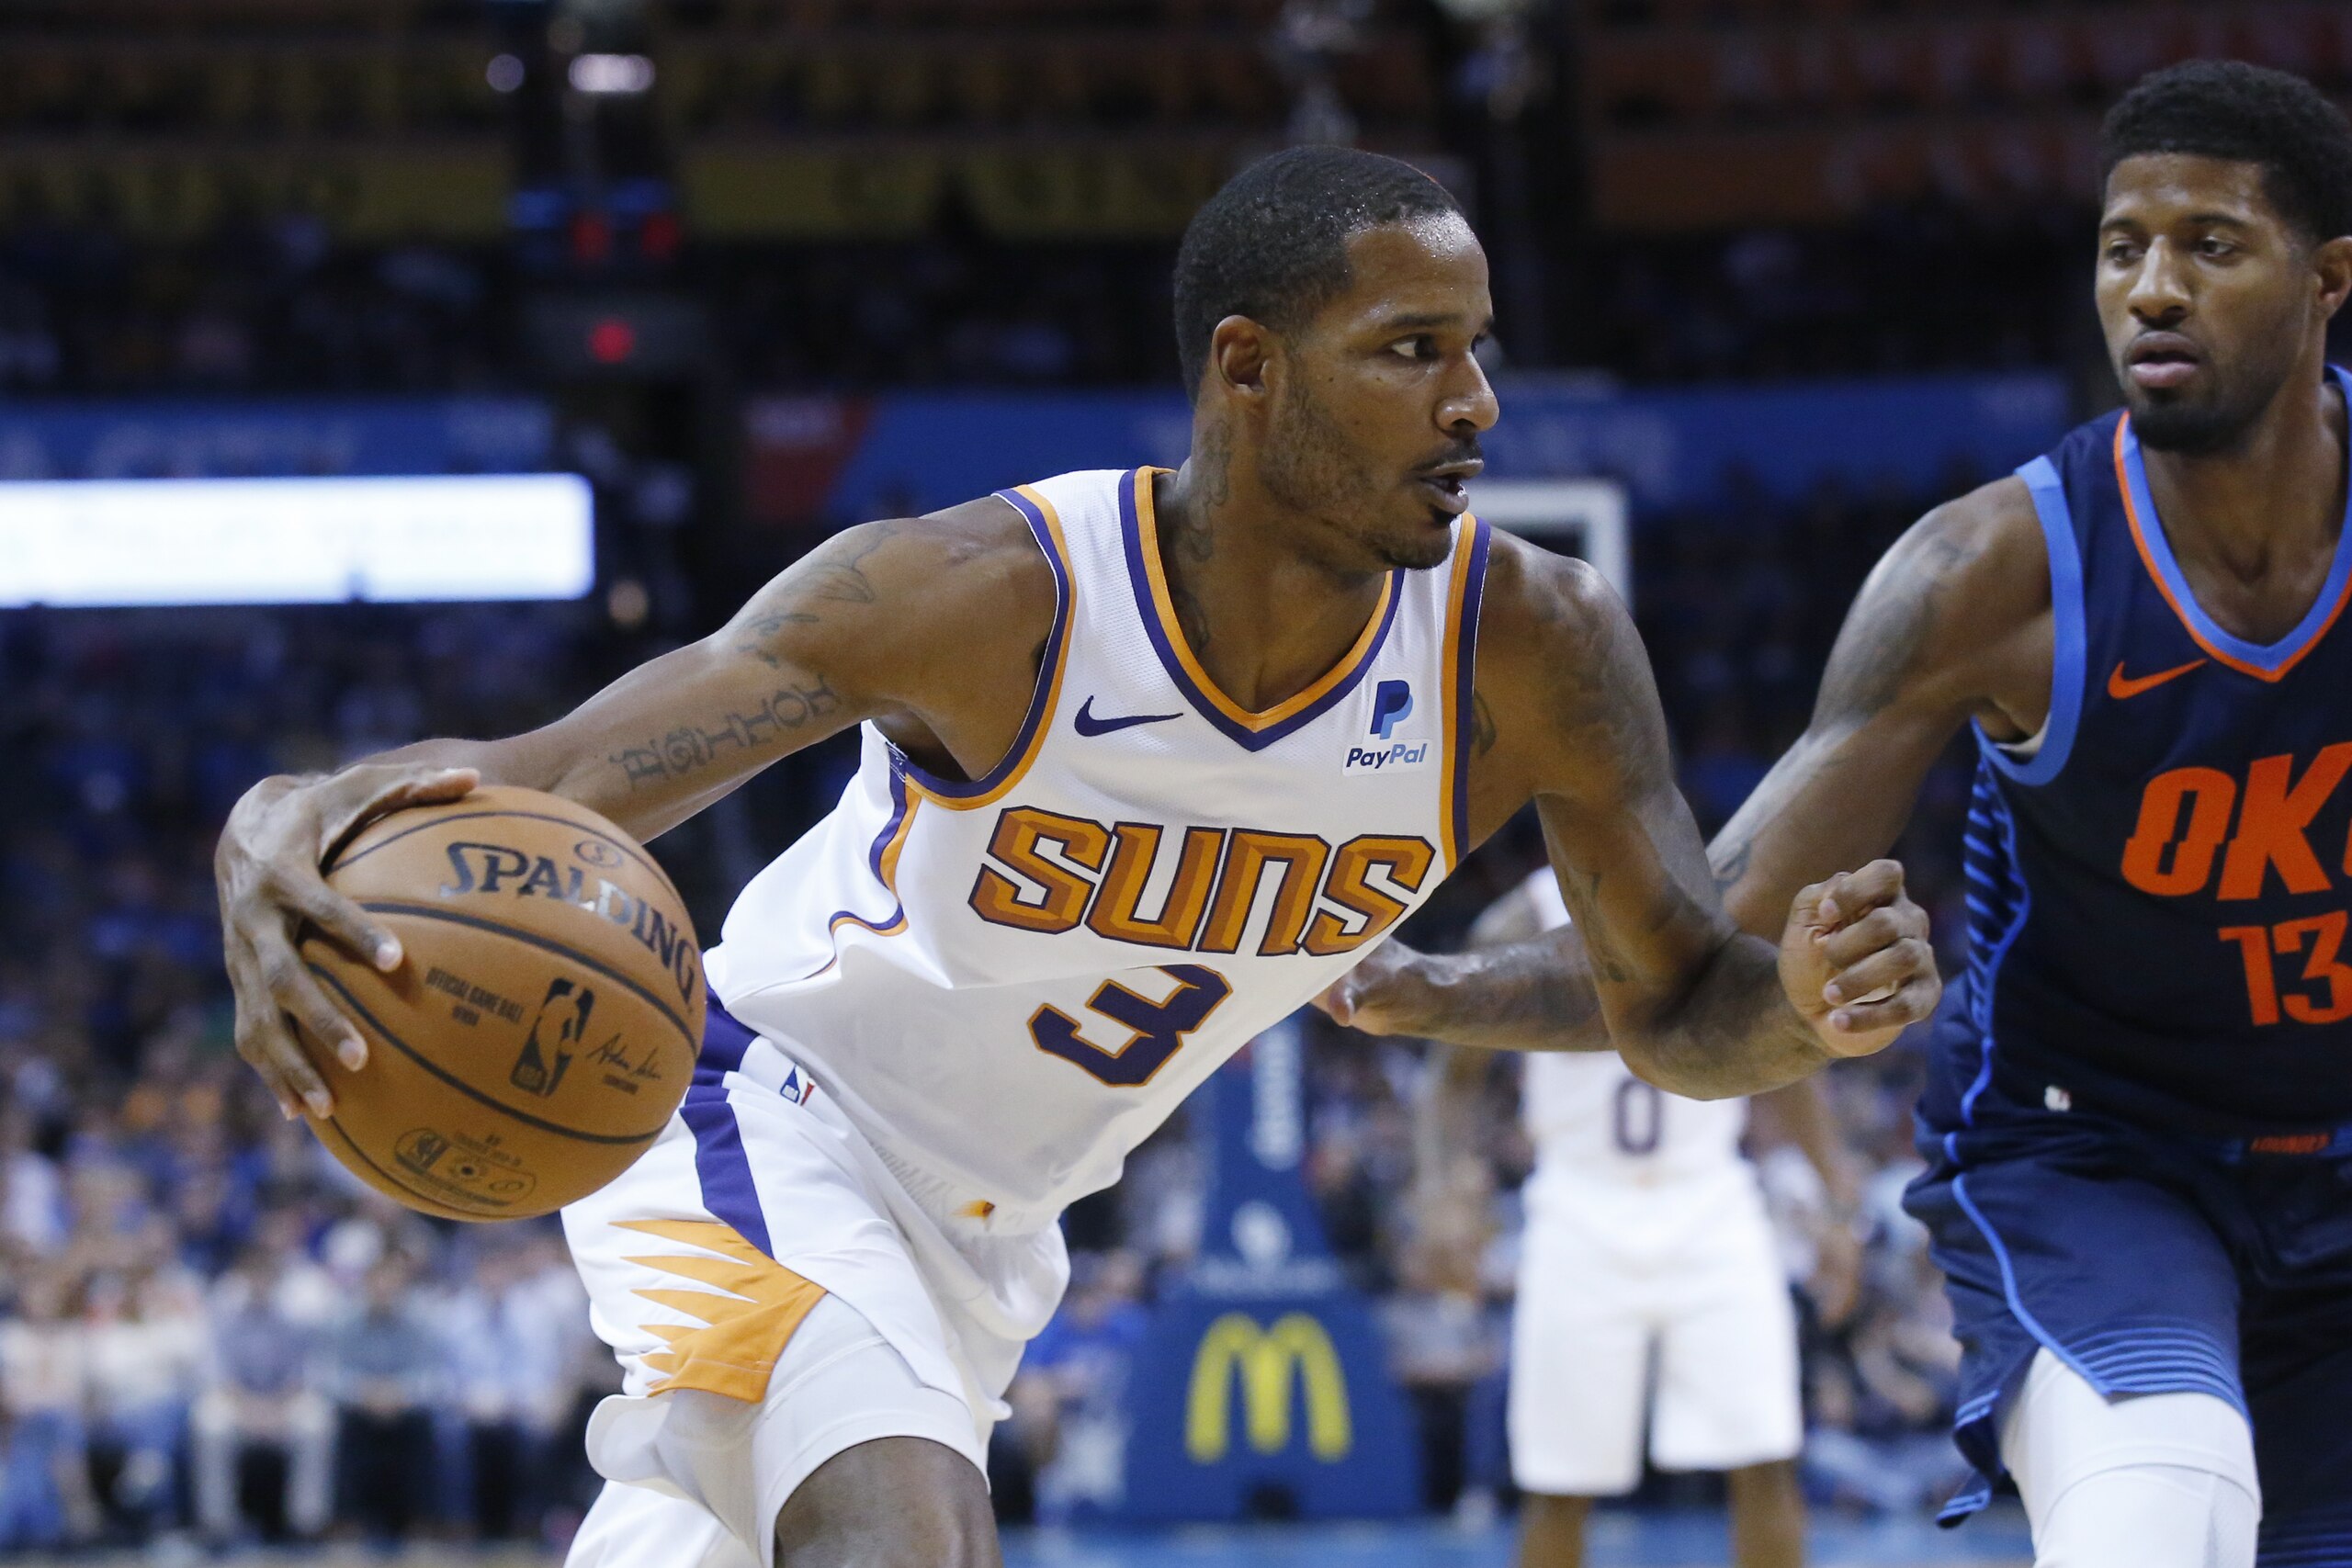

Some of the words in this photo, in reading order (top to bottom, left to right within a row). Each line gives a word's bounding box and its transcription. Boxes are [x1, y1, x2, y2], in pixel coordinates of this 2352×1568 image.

[1345, 742, 1429, 770] PayPal
[967, 805, 1436, 957] SUNS
[2120, 740, 2352, 902] OK
[438, 840, 695, 1005] SPALDING
[2217, 909, 2352, 1026] 13
[1026, 963, 1234, 1088] 3
[1614, 1077, 1663, 1156] 0
